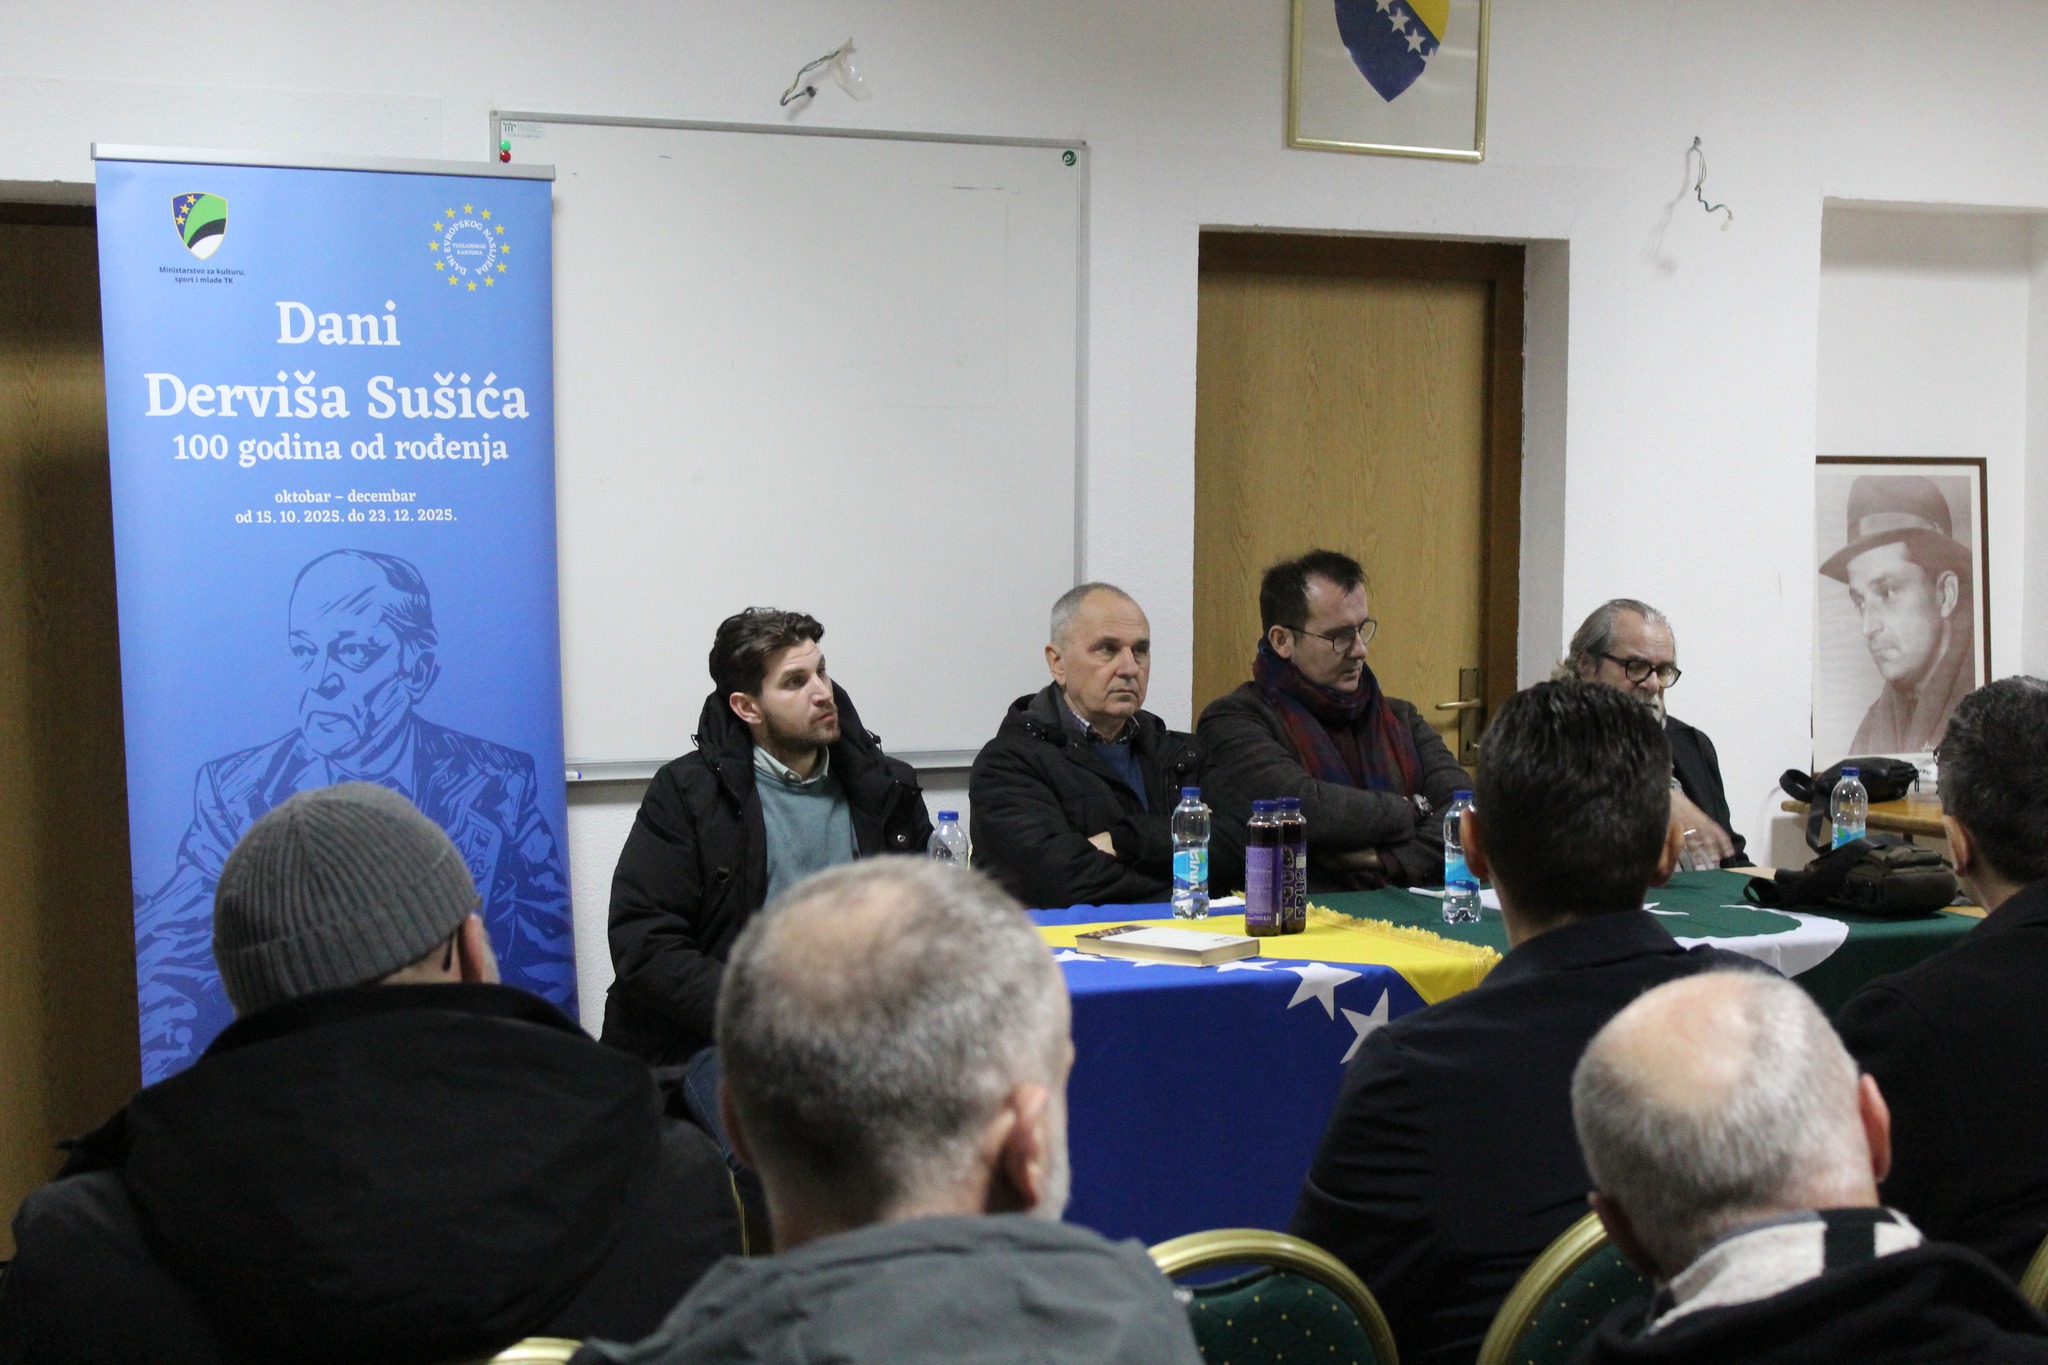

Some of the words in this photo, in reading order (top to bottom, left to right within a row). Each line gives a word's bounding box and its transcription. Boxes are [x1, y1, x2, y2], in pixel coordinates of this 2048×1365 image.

[443, 219, 483, 253] EVROPSKOG
[159, 266, 206, 275] Ministarstvo
[216, 268, 246, 277] kulturu,
[446, 254, 467, 276] DANI
[174, 276, 194, 284] sport
[275, 299, 401, 346] Dani
[144, 369, 350, 419] Derviša
[367, 370, 530, 419] Sušića
[173, 433, 229, 460] 100
[238, 432, 342, 468] godina
[350, 432, 387, 460] od
[395, 432, 509, 466] rođenja
[274, 489, 331, 504] oktobar
[347, 488, 416, 502] decembar
[235, 509, 253, 524] od
[256, 510, 277, 524] 15.
[280, 510, 300, 523] 10.
[304, 509, 345, 523] 2025.
[348, 508, 365, 522] do
[368, 509, 391, 522] 23.
[394, 508, 414, 522] 12.
[417, 508, 458, 522] 2025.
